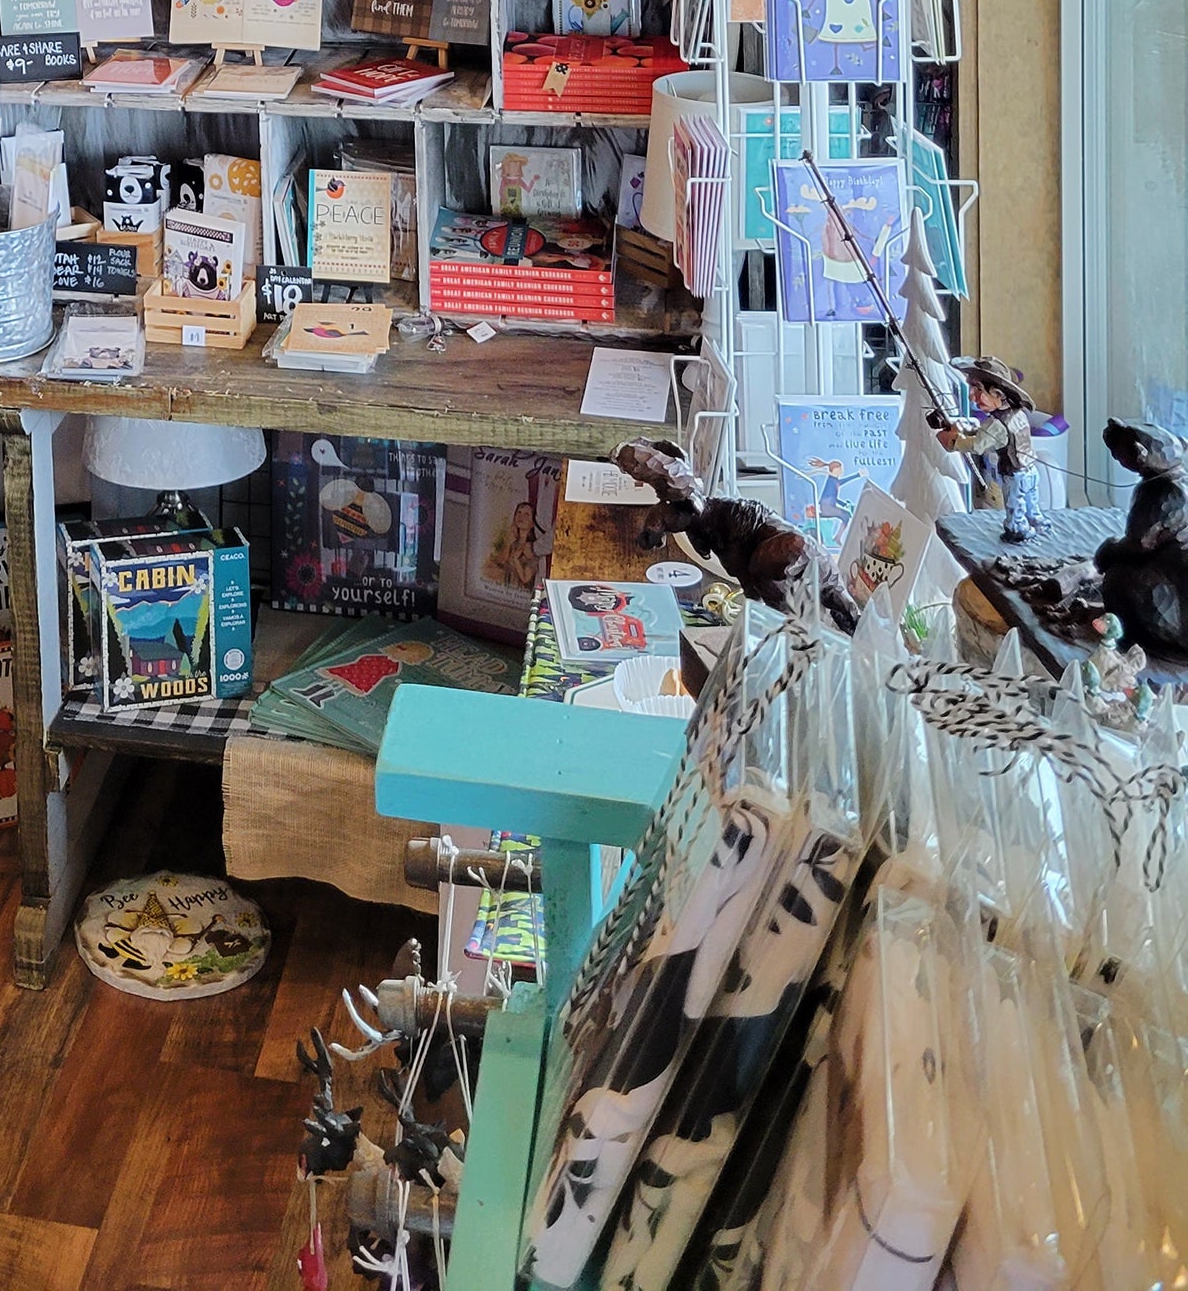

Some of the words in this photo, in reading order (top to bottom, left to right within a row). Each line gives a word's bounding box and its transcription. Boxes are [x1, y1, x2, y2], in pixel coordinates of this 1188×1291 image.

[392, 2, 414, 17] THEM
[29, 41, 62, 54] SHARE
[45, 54, 77, 65] BOOKS
[848, 175, 884, 189] Birthday!
[316, 203, 384, 225] PEACE
[87, 265, 103, 276] $14
[110, 257, 132, 266] SACK
[88, 254, 106, 264] $12
[441, 265, 459, 273] GREAT
[460, 266, 490, 274] AMERICAN
[492, 267, 513, 276] FAMILY
[541, 270, 572, 279] COOKBOOK
[84, 276, 105, 288] $16
[443, 277, 461, 285] GREAT
[462, 278, 492, 287] AMERICAN
[494, 279, 515, 288] FAMILY
[543, 283, 574, 292] COOKBOOK
[261, 278, 303, 313] $18
[813, 409, 855, 421] Break
[859, 410, 889, 421] free
[118, 565, 196, 592] CABIN
[331, 585, 416, 606] yourself!
[219, 674, 242, 682] 1000
[140, 677, 209, 699] WOODS
[100, 892, 139, 909] Bee
[167, 886, 228, 911] Happy
